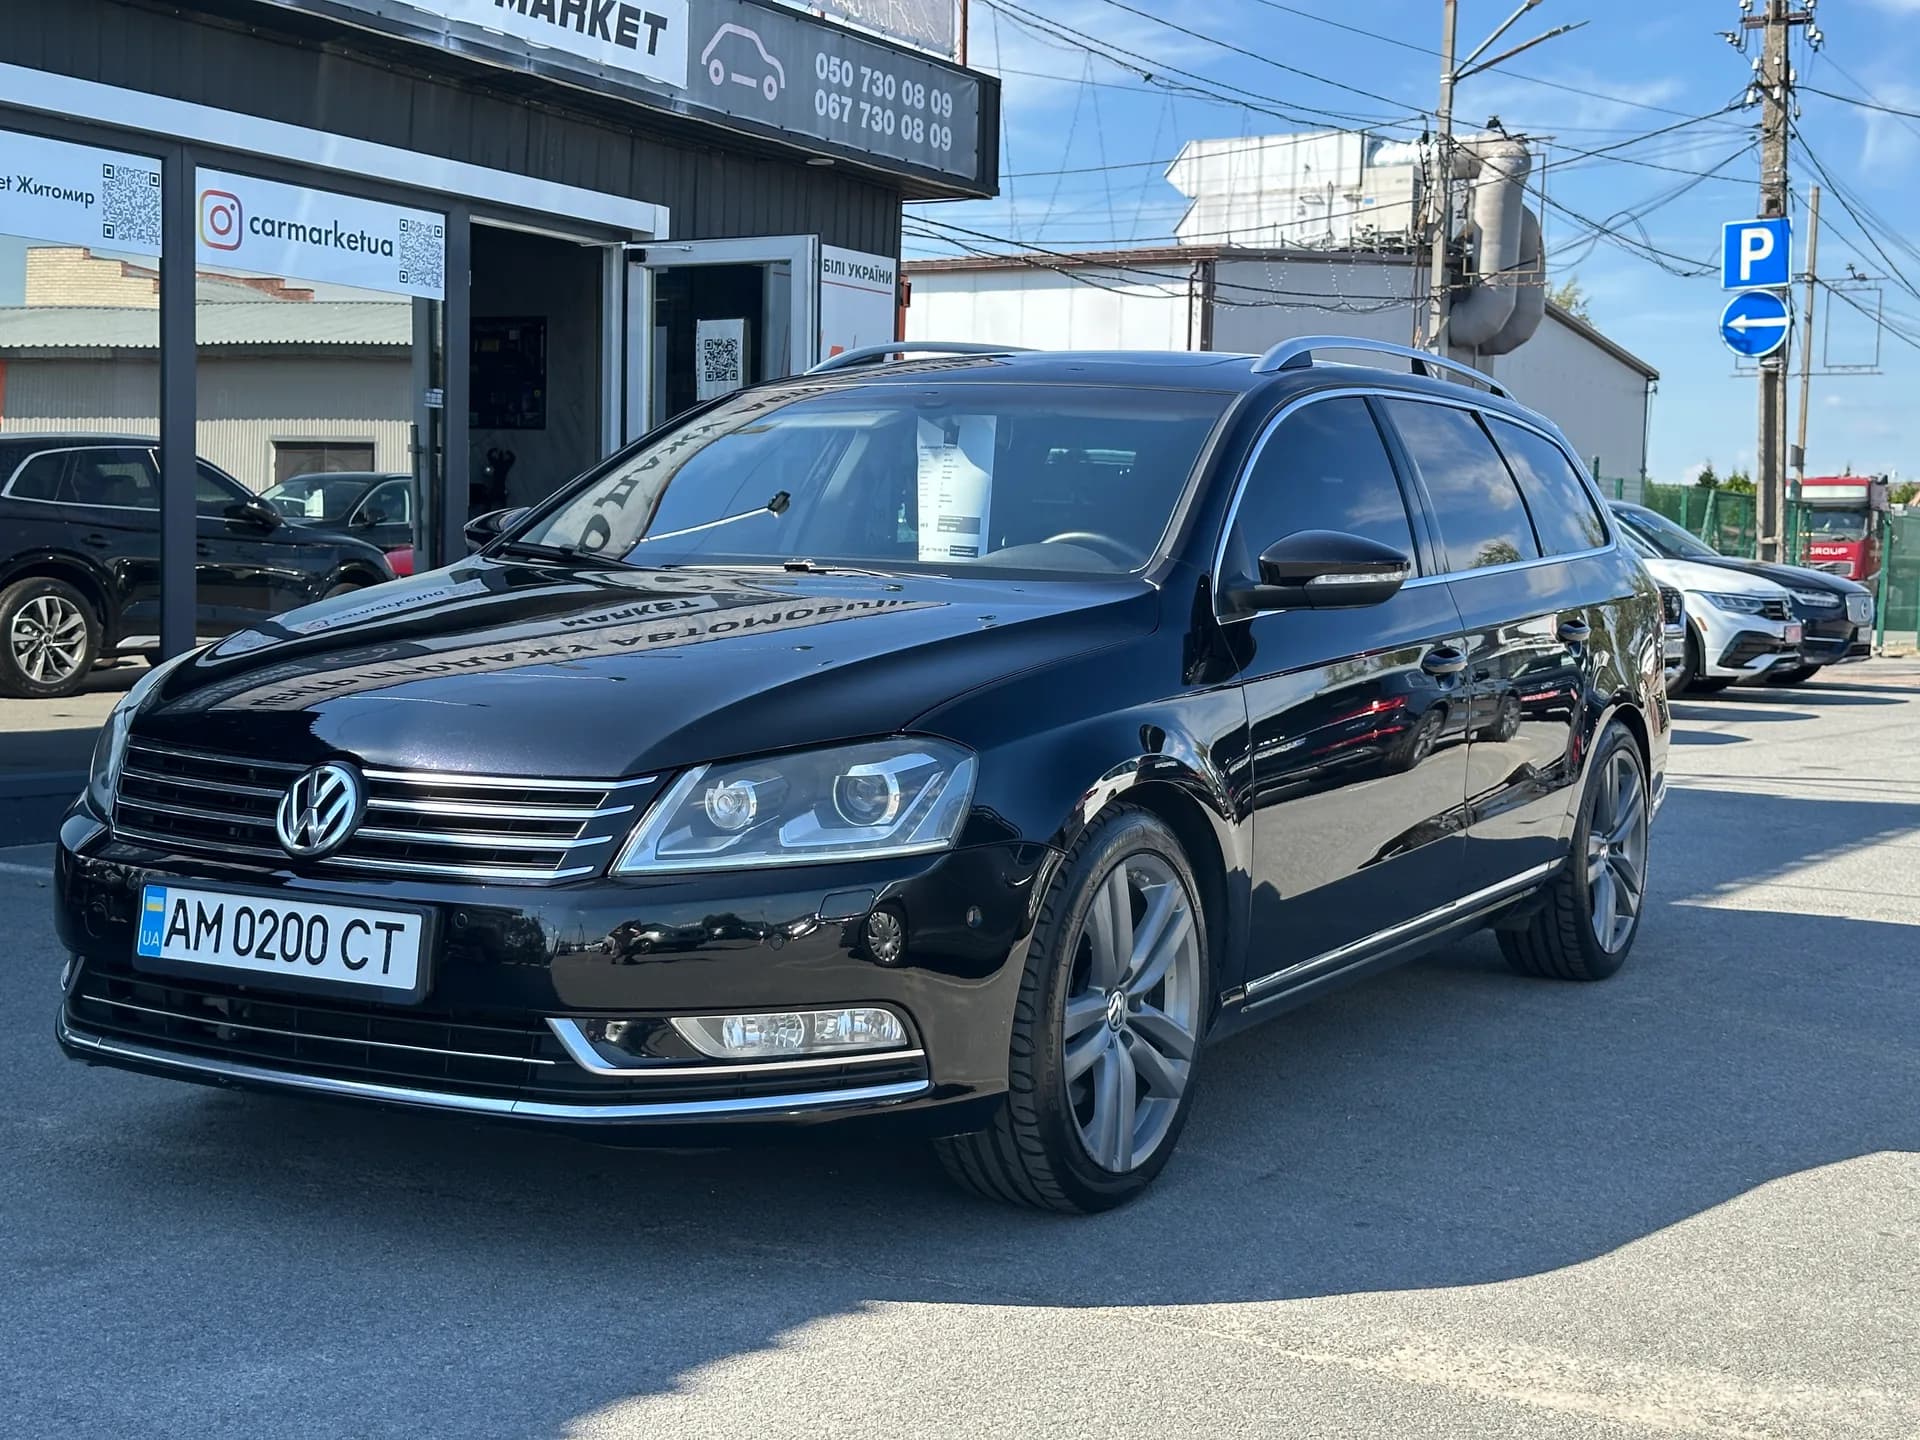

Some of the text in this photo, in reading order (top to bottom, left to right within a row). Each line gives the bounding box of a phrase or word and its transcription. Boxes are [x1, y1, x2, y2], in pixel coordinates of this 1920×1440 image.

[494, 0, 668, 56] ARKET
[815, 52, 953, 118] 050 730 08 09
[814, 88, 952, 151] 067 730 08 09
[16, 175, 95, 208] Житомир
[250, 215, 394, 257] carmarketua
[1740, 228, 1774, 281] P
[821, 258, 893, 285] БІЛІ УКРАЇНИ
[143, 931, 160, 948] UA
[163, 898, 405, 974] AM 0200 CT
